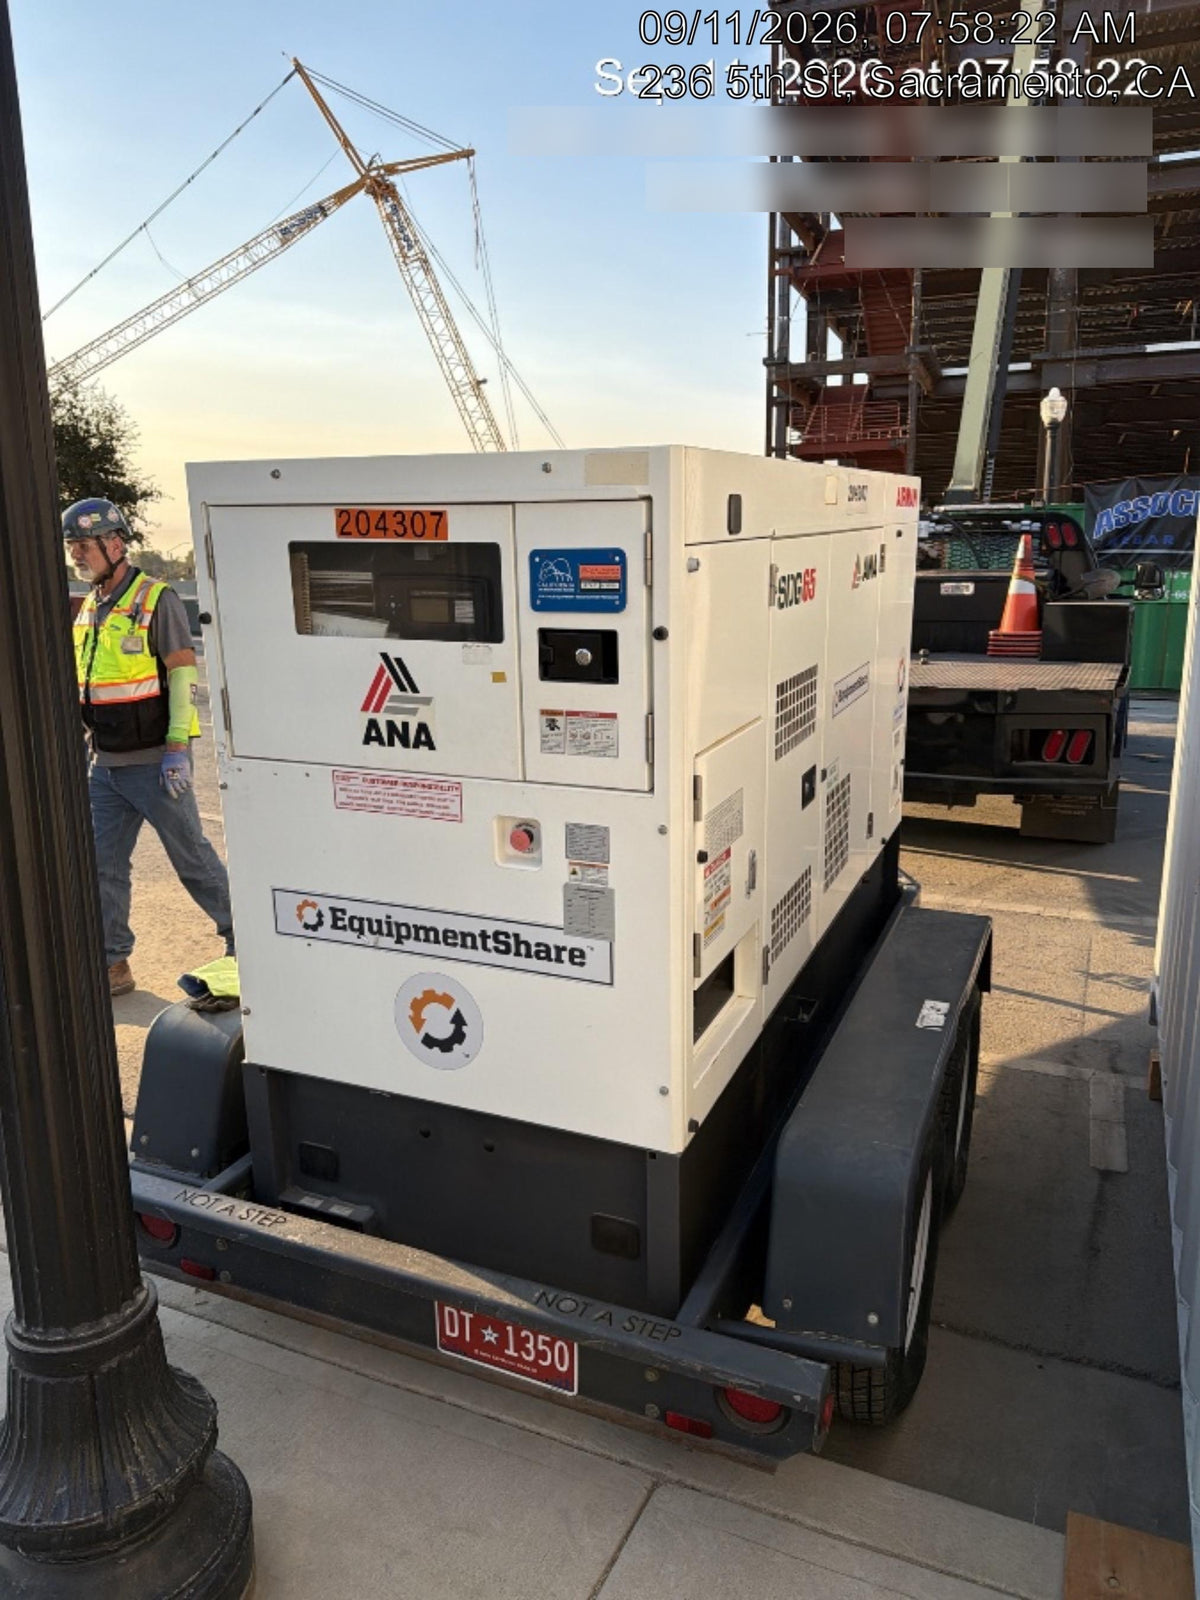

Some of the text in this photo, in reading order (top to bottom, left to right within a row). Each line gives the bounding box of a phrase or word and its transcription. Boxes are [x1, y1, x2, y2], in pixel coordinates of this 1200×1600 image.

[337, 509, 444, 538] 204307
[777, 568, 817, 610] SDG65
[362, 718, 436, 750] ANA
[328, 906, 587, 968] EquipmentShare
[174, 1188, 287, 1228] NOT A STEP
[535, 1290, 682, 1342] NOT A STEP
[443, 1305, 474, 1343] DT
[504, 1325, 570, 1373] 1350
